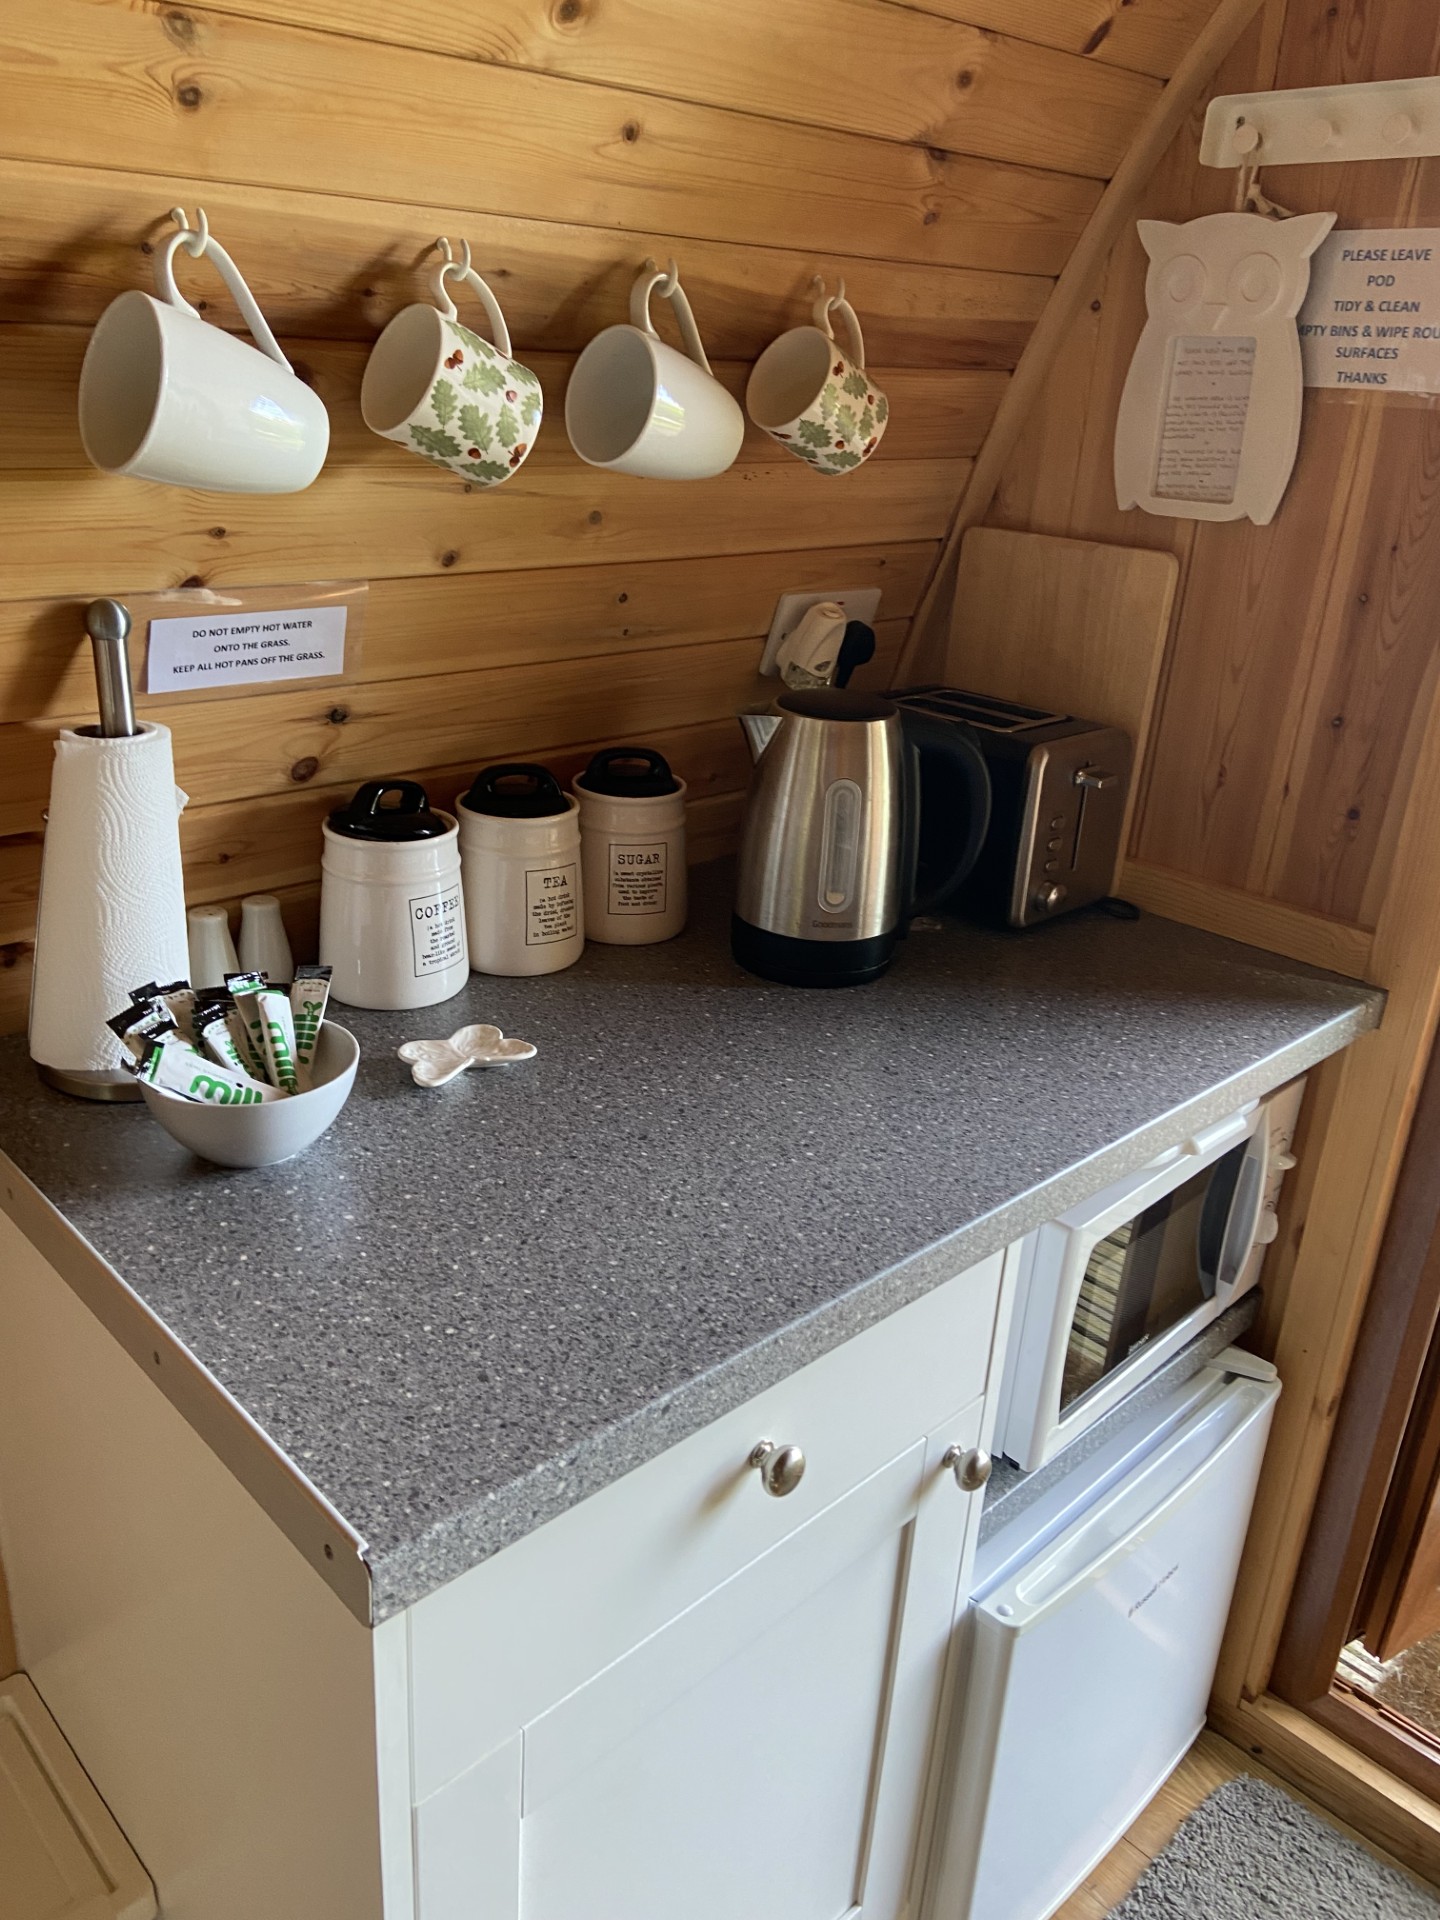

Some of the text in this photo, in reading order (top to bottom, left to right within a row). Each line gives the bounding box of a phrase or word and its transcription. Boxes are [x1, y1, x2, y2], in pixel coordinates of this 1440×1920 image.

[1342, 249, 1432, 261] PLEASE LEAVE
[1367, 275, 1396, 287] POD
[1334, 301, 1421, 312] TIDY & CLEAN
[1330, 325, 1359, 337] BINS
[1362, 325, 1372, 338] &
[1377, 326, 1410, 338] WIPE
[1335, 347, 1399, 360] SURFACES
[1337, 371, 1388, 384] THANKS
[192, 620, 313, 638] DO NOT EMPTY HOT WATER
[213, 639, 291, 653] ONTO THE GRASS.
[173, 651, 326, 674] KEEP ALL HOT PANS OFF THE GRASS.
[617, 853, 661, 866] SUGAR
[543, 875, 568, 889] TEA
[415, 895, 460, 920] COFFEE
